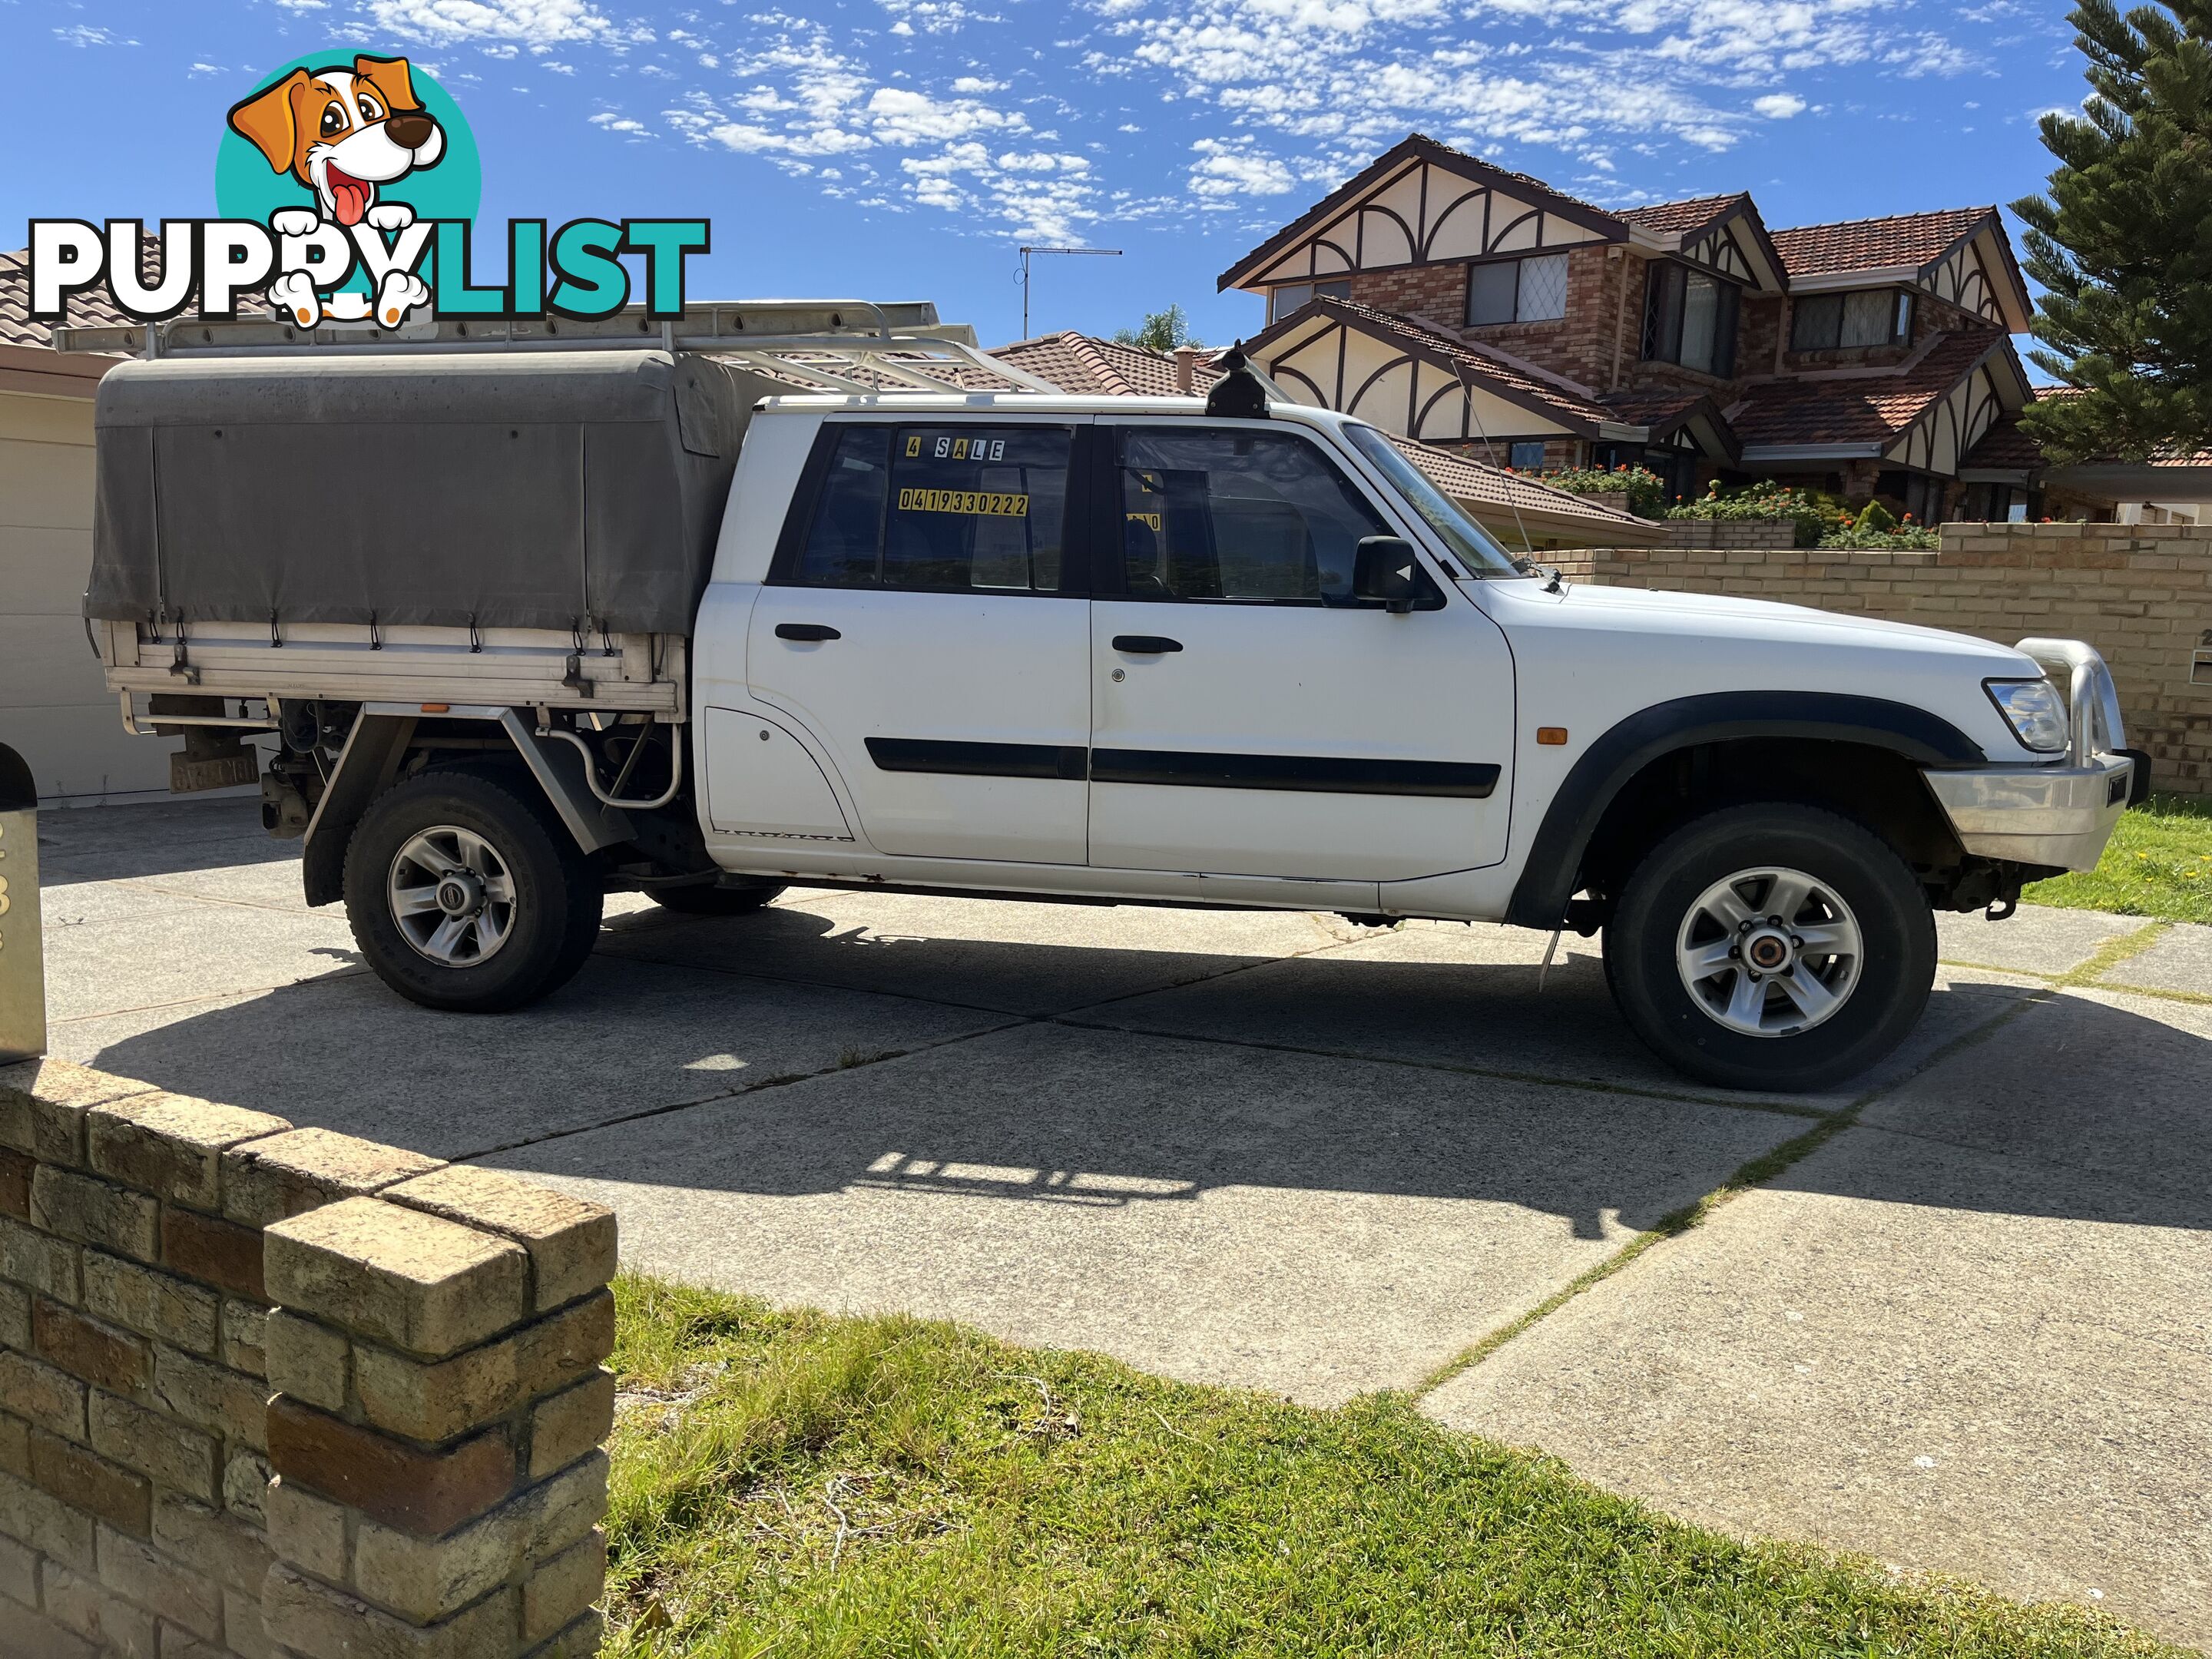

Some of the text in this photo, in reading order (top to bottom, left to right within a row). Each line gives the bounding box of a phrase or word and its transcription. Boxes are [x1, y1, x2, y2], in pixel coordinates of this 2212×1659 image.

[907, 437, 1003, 459] 4 SALE
[900, 490, 1027, 515] 0419330222
